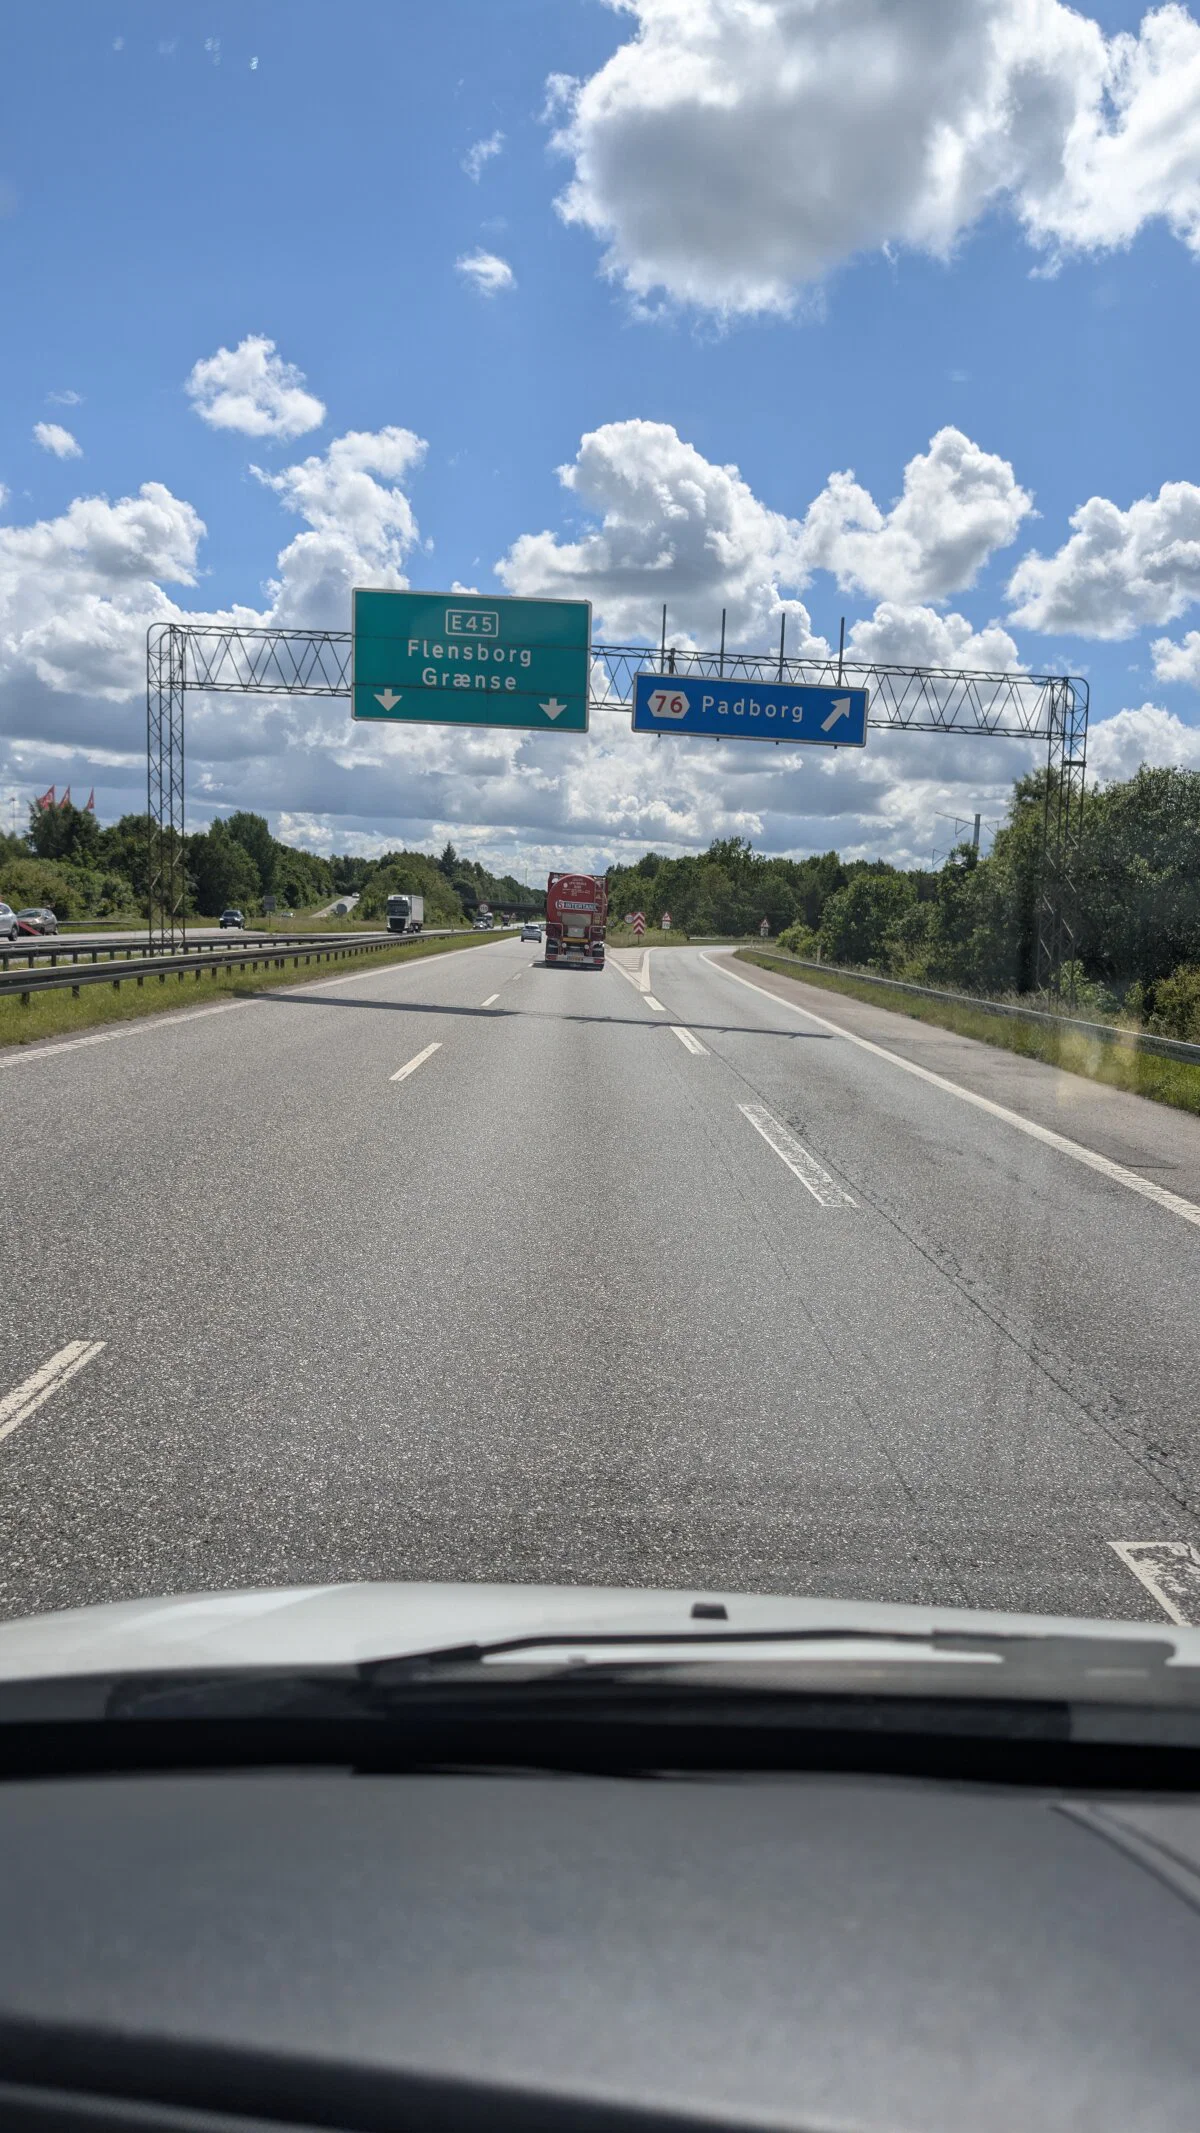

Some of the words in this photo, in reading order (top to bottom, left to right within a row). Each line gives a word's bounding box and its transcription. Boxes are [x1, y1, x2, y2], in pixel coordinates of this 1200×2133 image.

[452, 614, 492, 632] E45
[407, 639, 532, 668] Flensborg
[422, 667, 517, 690] Grænse
[655, 695, 683, 713] 76
[702, 695, 804, 723] Padborg
